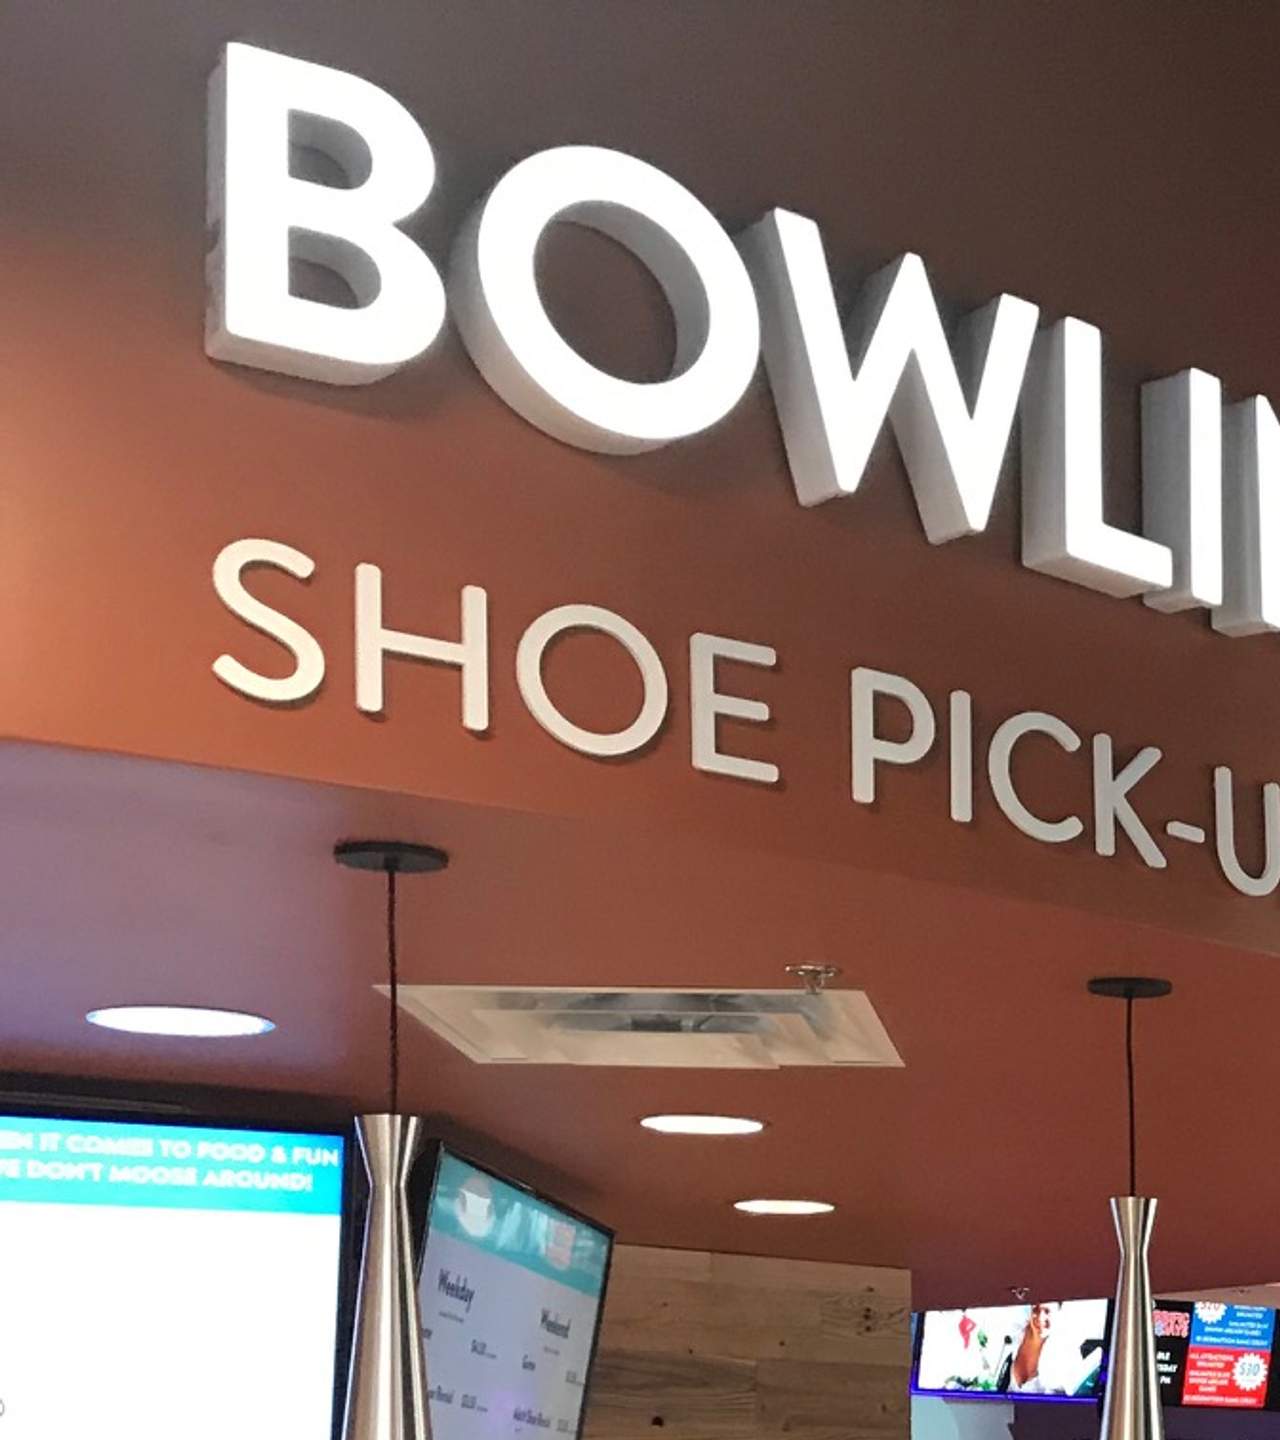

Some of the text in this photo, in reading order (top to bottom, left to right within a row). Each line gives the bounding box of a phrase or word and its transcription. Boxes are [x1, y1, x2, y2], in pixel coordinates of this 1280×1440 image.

[210, 538, 780, 785] SHOE
[159, 1138, 192, 1160] TO
[292, 1147, 339, 1167] FUN
